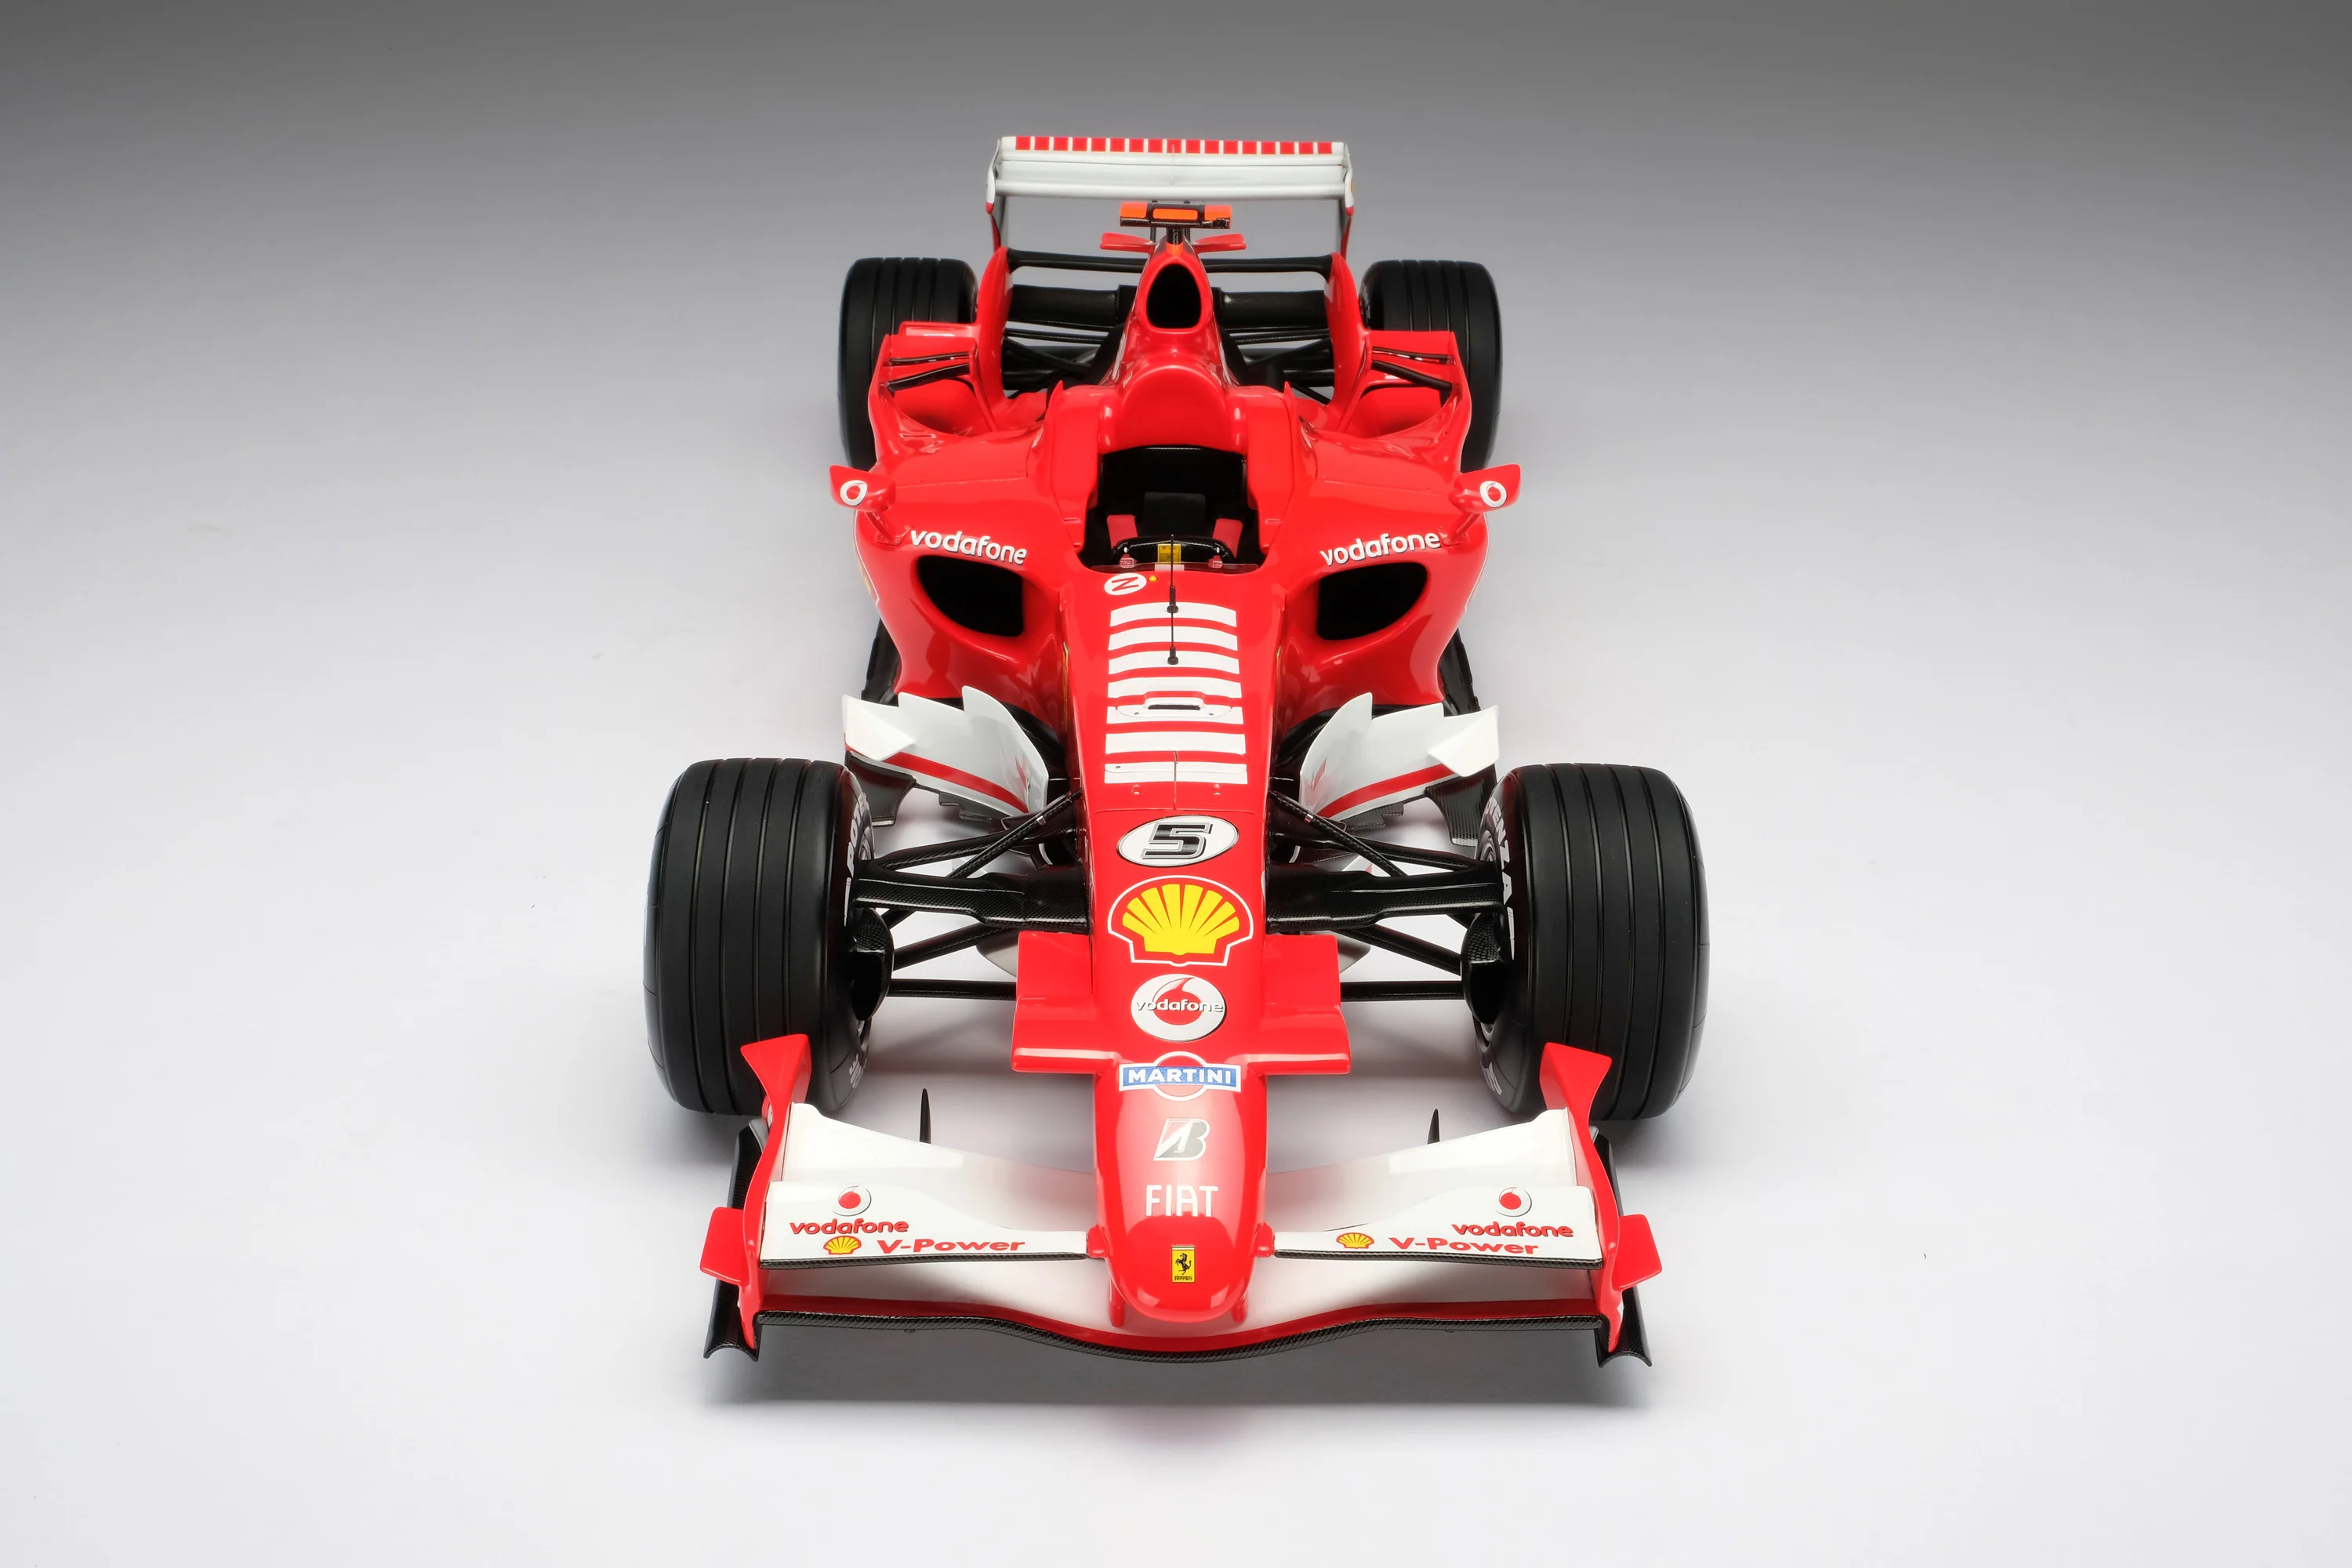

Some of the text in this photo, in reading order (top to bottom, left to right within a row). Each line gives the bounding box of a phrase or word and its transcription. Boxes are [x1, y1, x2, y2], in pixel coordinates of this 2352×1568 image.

[910, 529, 1027, 565] vodafone
[1319, 532, 1441, 566] vodafone
[1141, 822, 1213, 859] 5
[1136, 999, 1224, 1013] vodafone
[1128, 1069, 1231, 1084] MARTINI
[1145, 1185, 1219, 1217] FIAT
[789, 1218, 909, 1235] vodafone
[1451, 1221, 1573, 1237] vodafone
[877, 1239, 1025, 1254] V-Power
[1388, 1237, 1539, 1254] V-Power
